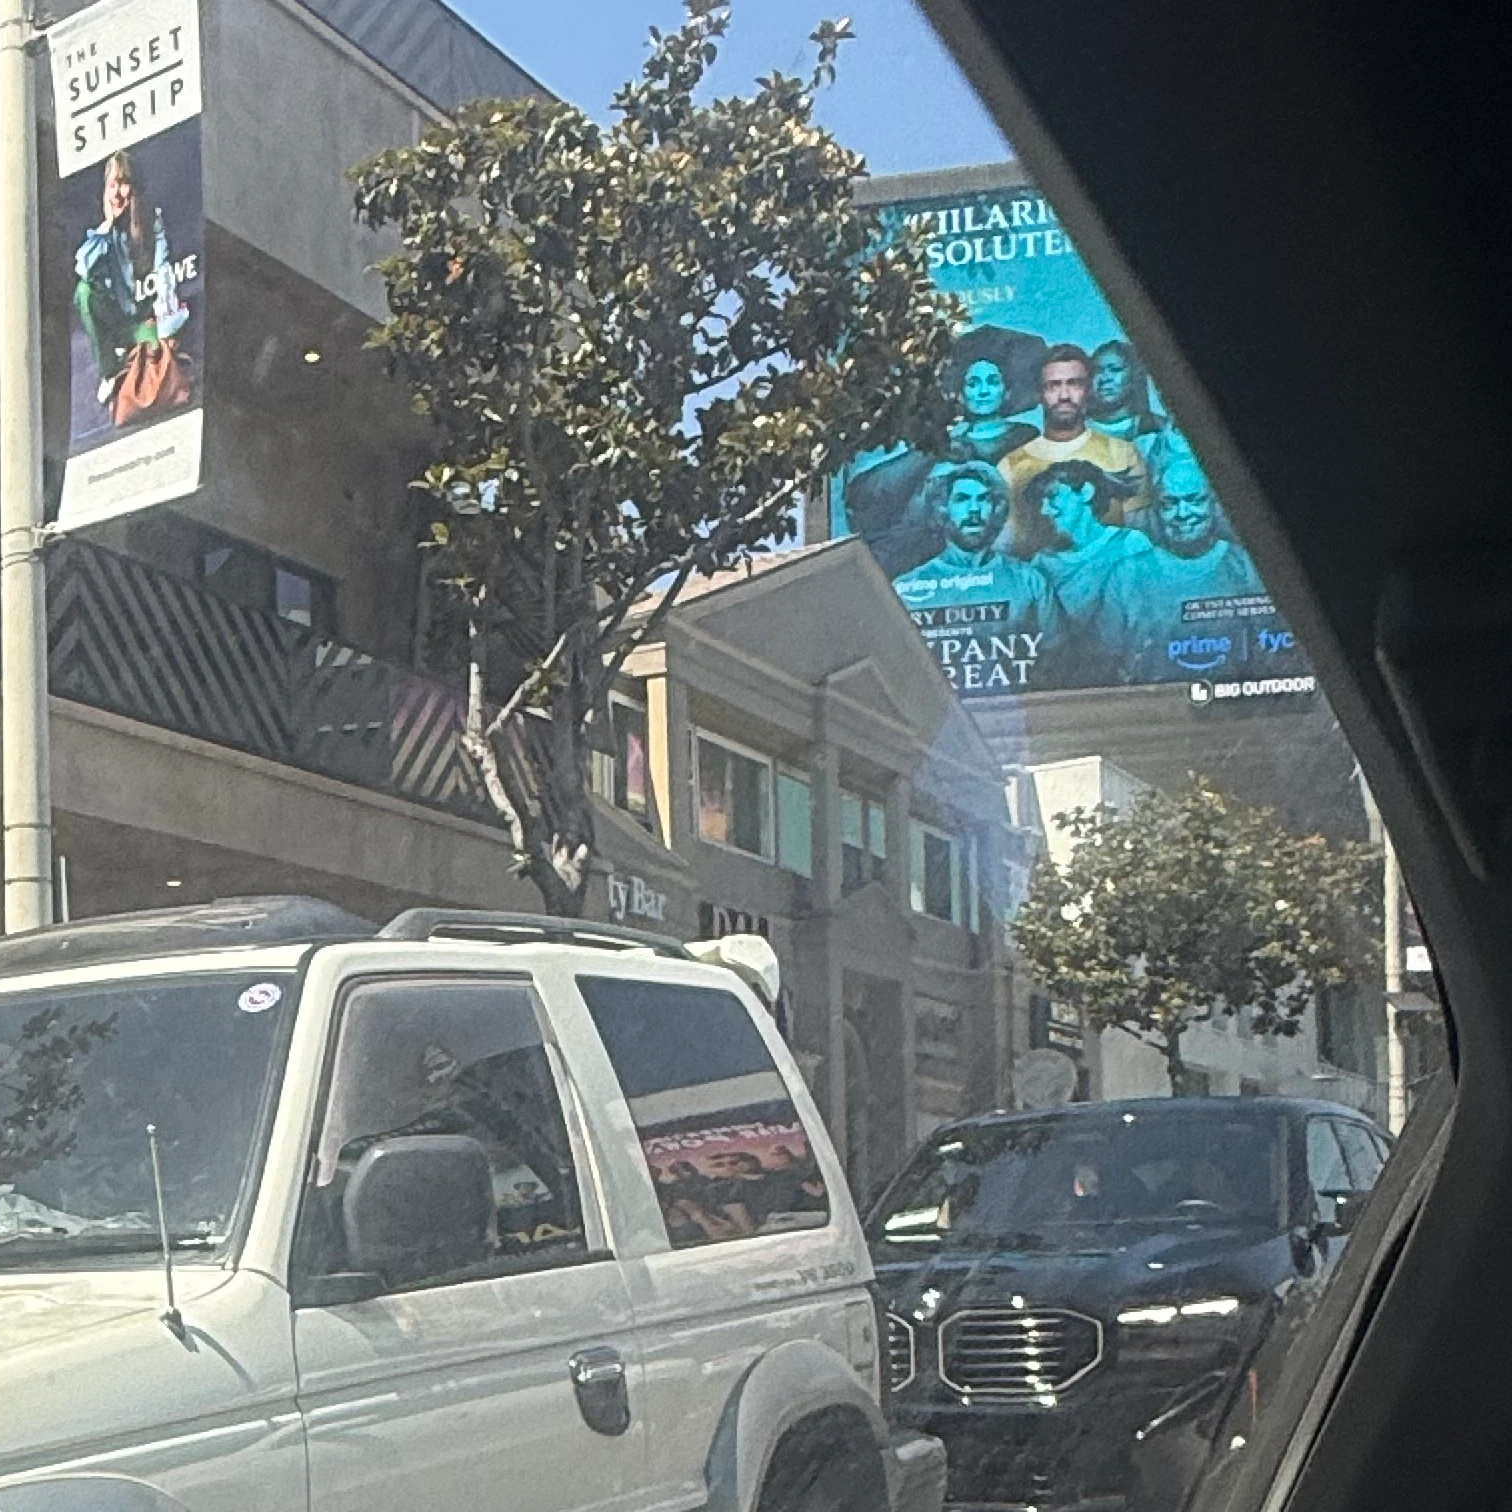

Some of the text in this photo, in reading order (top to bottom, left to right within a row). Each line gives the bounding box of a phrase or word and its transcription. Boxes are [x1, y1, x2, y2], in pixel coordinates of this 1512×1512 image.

[67, 42, 97, 69] THE
[69, 26, 182, 101] SUNSET
[74, 78, 184, 153] STRIP
[945, 603, 1005, 625] DUTY
[926, 632, 1044, 666] PANY
[1168, 628, 1296, 661] prime fyc
[1214, 675, 1316, 699] BIG OUTDOOR
[629, 876, 666, 921] Bar
